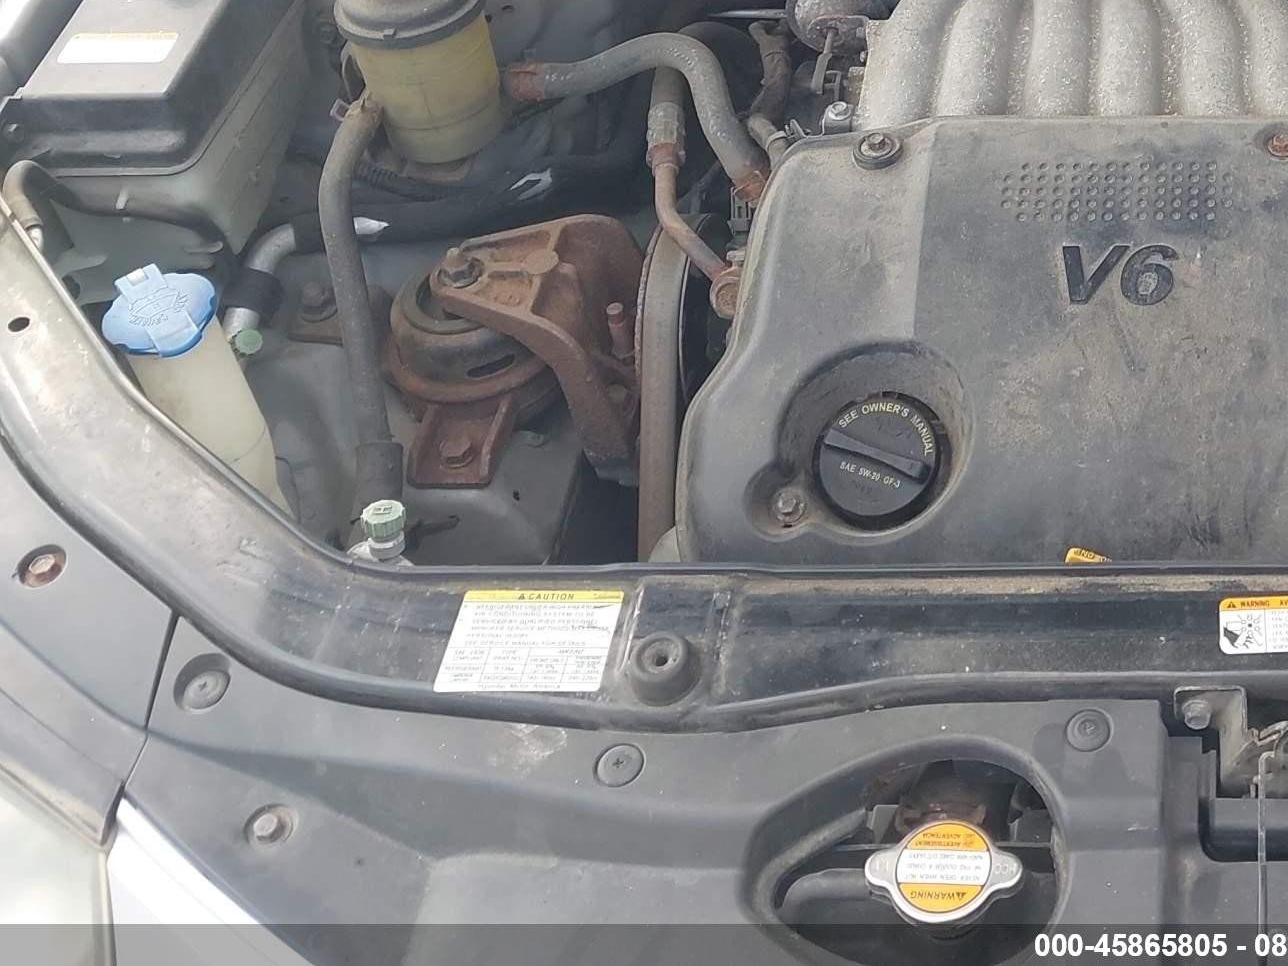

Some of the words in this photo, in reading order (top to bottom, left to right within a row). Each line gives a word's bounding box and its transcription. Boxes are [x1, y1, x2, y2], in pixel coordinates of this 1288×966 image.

[1062, 244, 1179, 306] V6
[839, 409, 858, 428] SEE
[862, 402, 910, 417] OWNER'S
[909, 415, 934, 457] MANUAL
[839, 461, 857, 473] SAE
[529, 593, 575, 601] CAUTION
[1240, 600, 1270, 608] WARNING
[910, 890, 956, 899] WARNING
